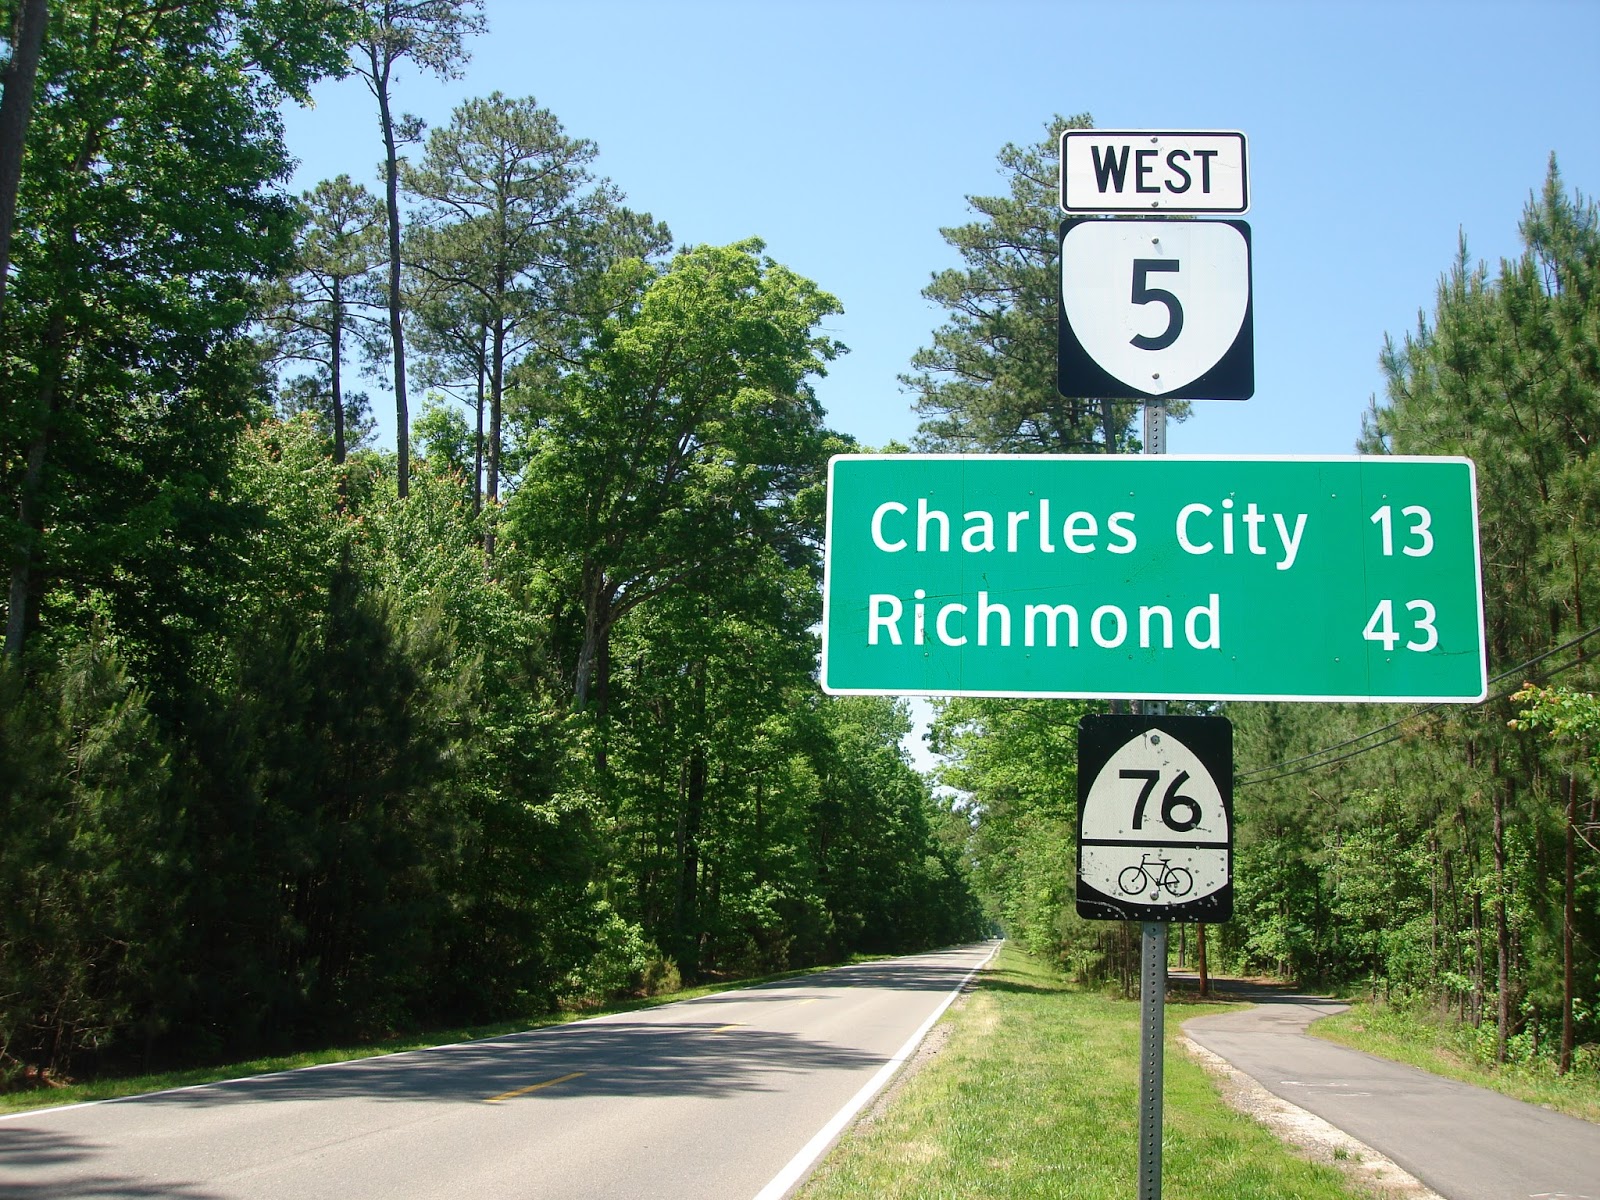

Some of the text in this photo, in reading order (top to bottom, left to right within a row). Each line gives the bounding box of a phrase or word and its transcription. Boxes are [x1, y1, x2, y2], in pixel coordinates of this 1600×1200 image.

[1090, 145, 1219, 194] WEST
[1129, 258, 1184, 351] 5
[870, 497, 1435, 571] Charles City 13
[867, 589, 1439, 653] Richmond 43
[1118, 769, 1203, 833] 76
